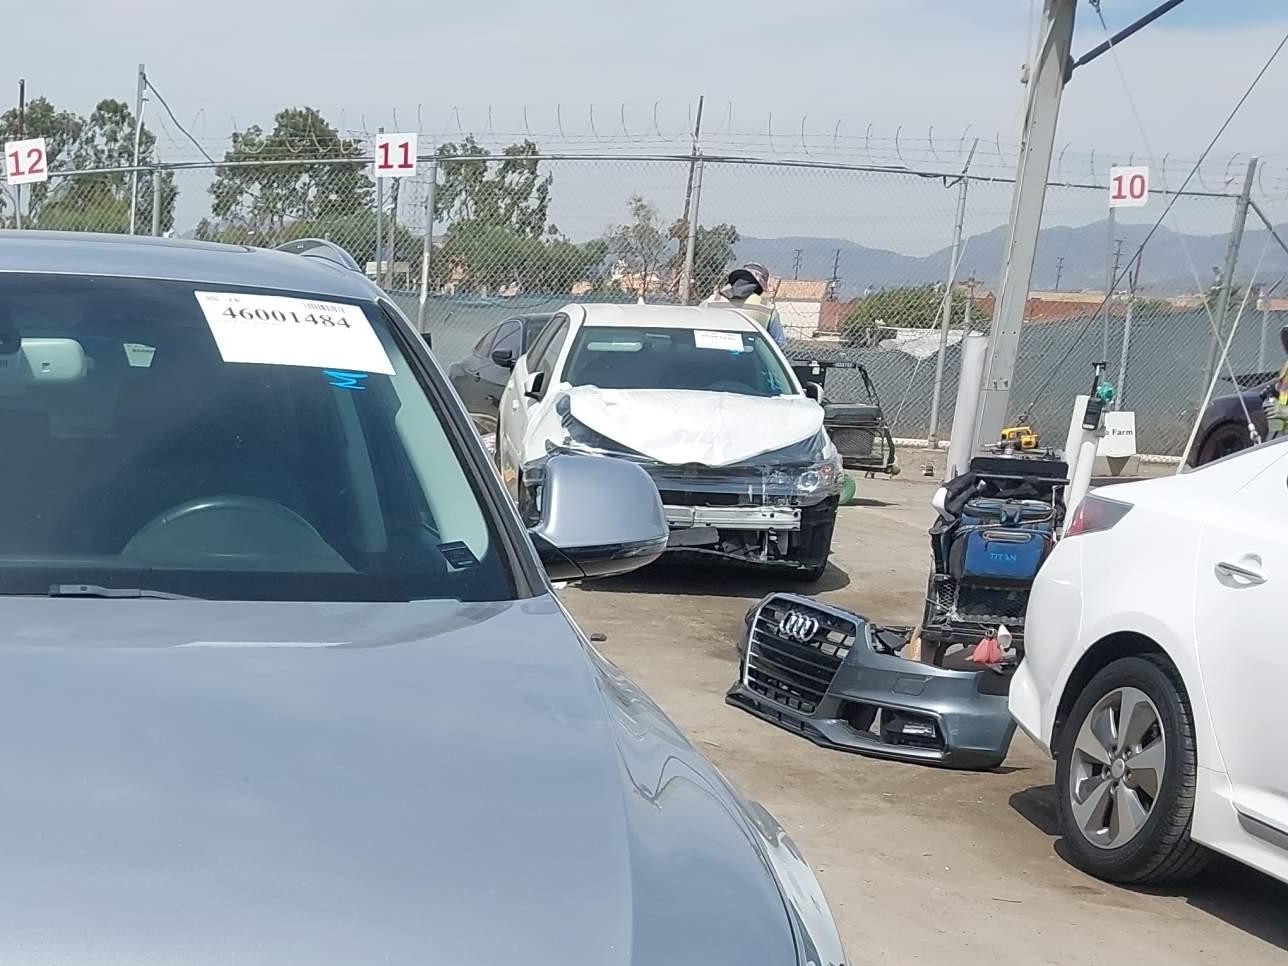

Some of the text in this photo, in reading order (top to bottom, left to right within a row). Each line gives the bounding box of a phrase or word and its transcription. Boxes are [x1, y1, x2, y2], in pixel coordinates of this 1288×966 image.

[8, 148, 44, 177] 12
[378, 141, 414, 169] 11
[1112, 174, 1145, 200] 10
[222, 307, 352, 329] 46001484
[1112, 428, 1133, 436] Farm
